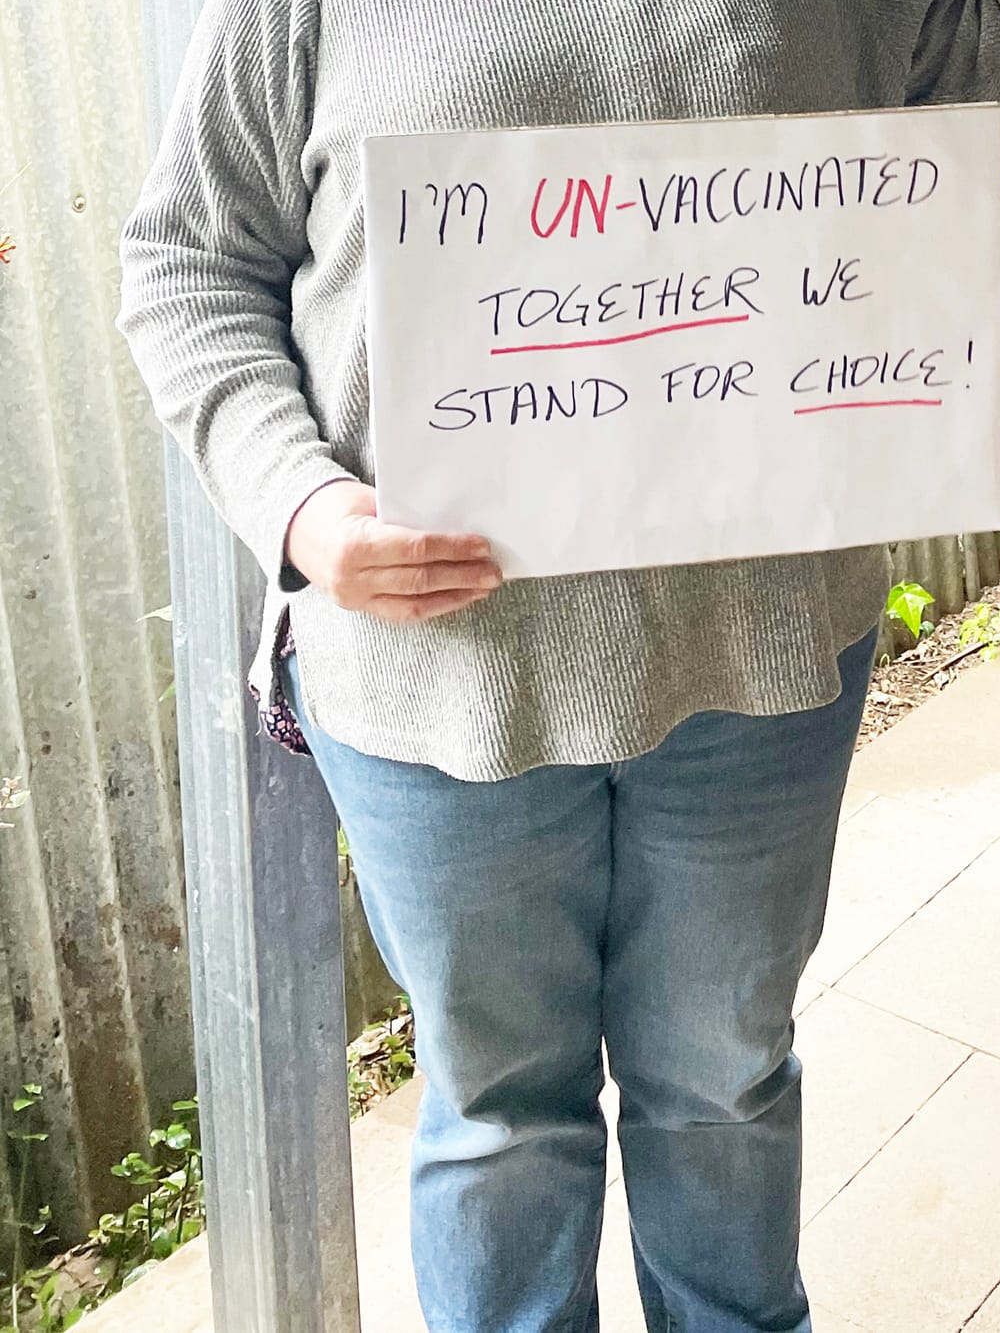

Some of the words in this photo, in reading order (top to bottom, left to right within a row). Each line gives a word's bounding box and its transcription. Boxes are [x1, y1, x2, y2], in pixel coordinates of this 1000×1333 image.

[399, 183, 488, 245] I'M
[530, 156, 939, 238] UN-VACCINATED
[479, 266, 765, 336] TOGETHER
[802, 258, 874, 306] WE
[428, 378, 629, 432] STAND
[661, 361, 758, 404] FOR
[790, 339, 974, 395] CHOICE!
